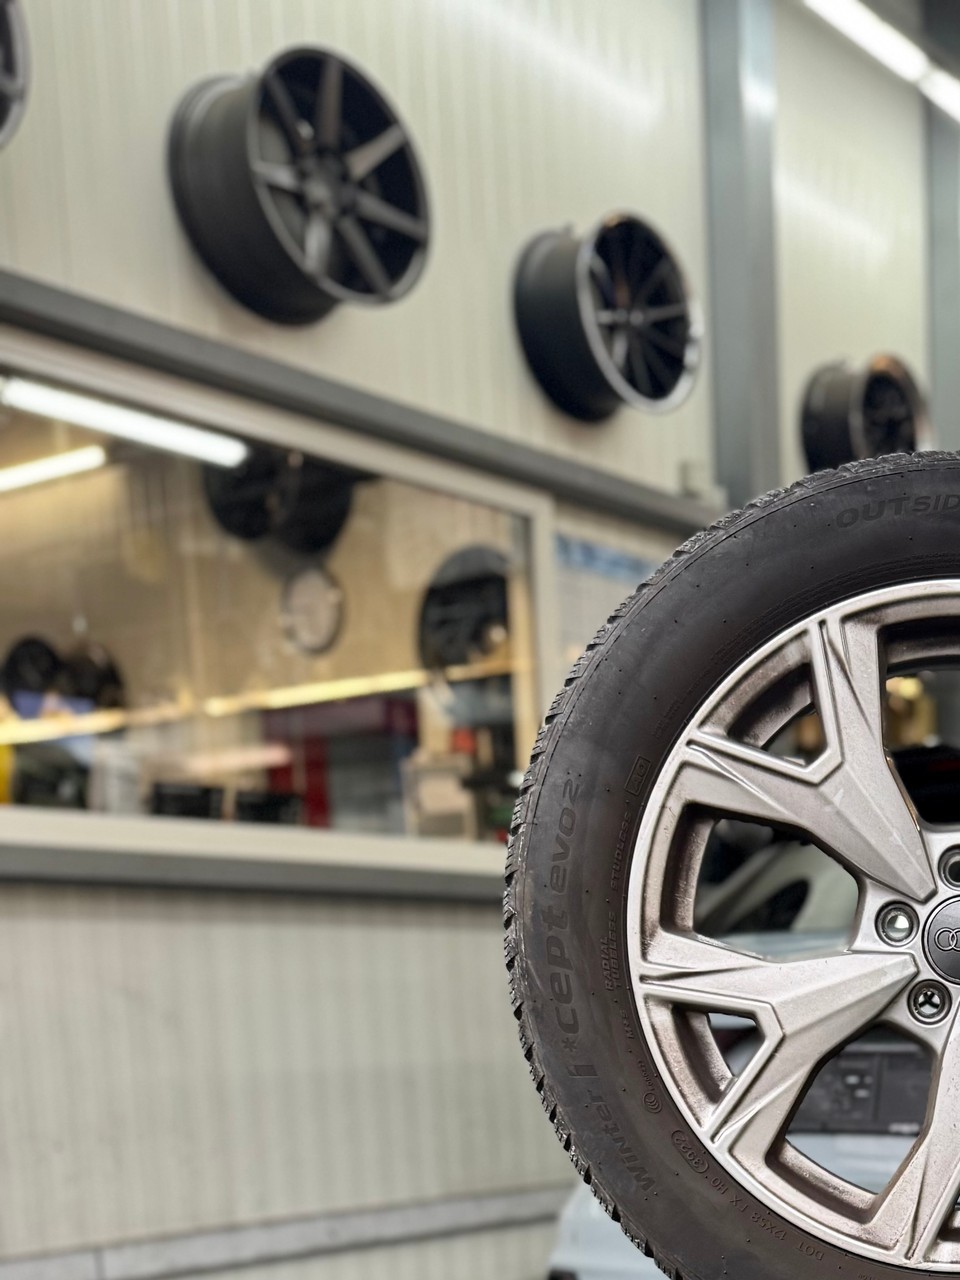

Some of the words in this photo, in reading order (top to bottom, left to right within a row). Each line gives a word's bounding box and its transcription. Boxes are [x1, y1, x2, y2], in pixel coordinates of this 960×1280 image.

[599, 935, 614, 991] RADIAL
[609, 911, 622, 987] TUBELESS
[585, 1088, 657, 1192] Winter
[794, 1239, 826, 1262] DOT
